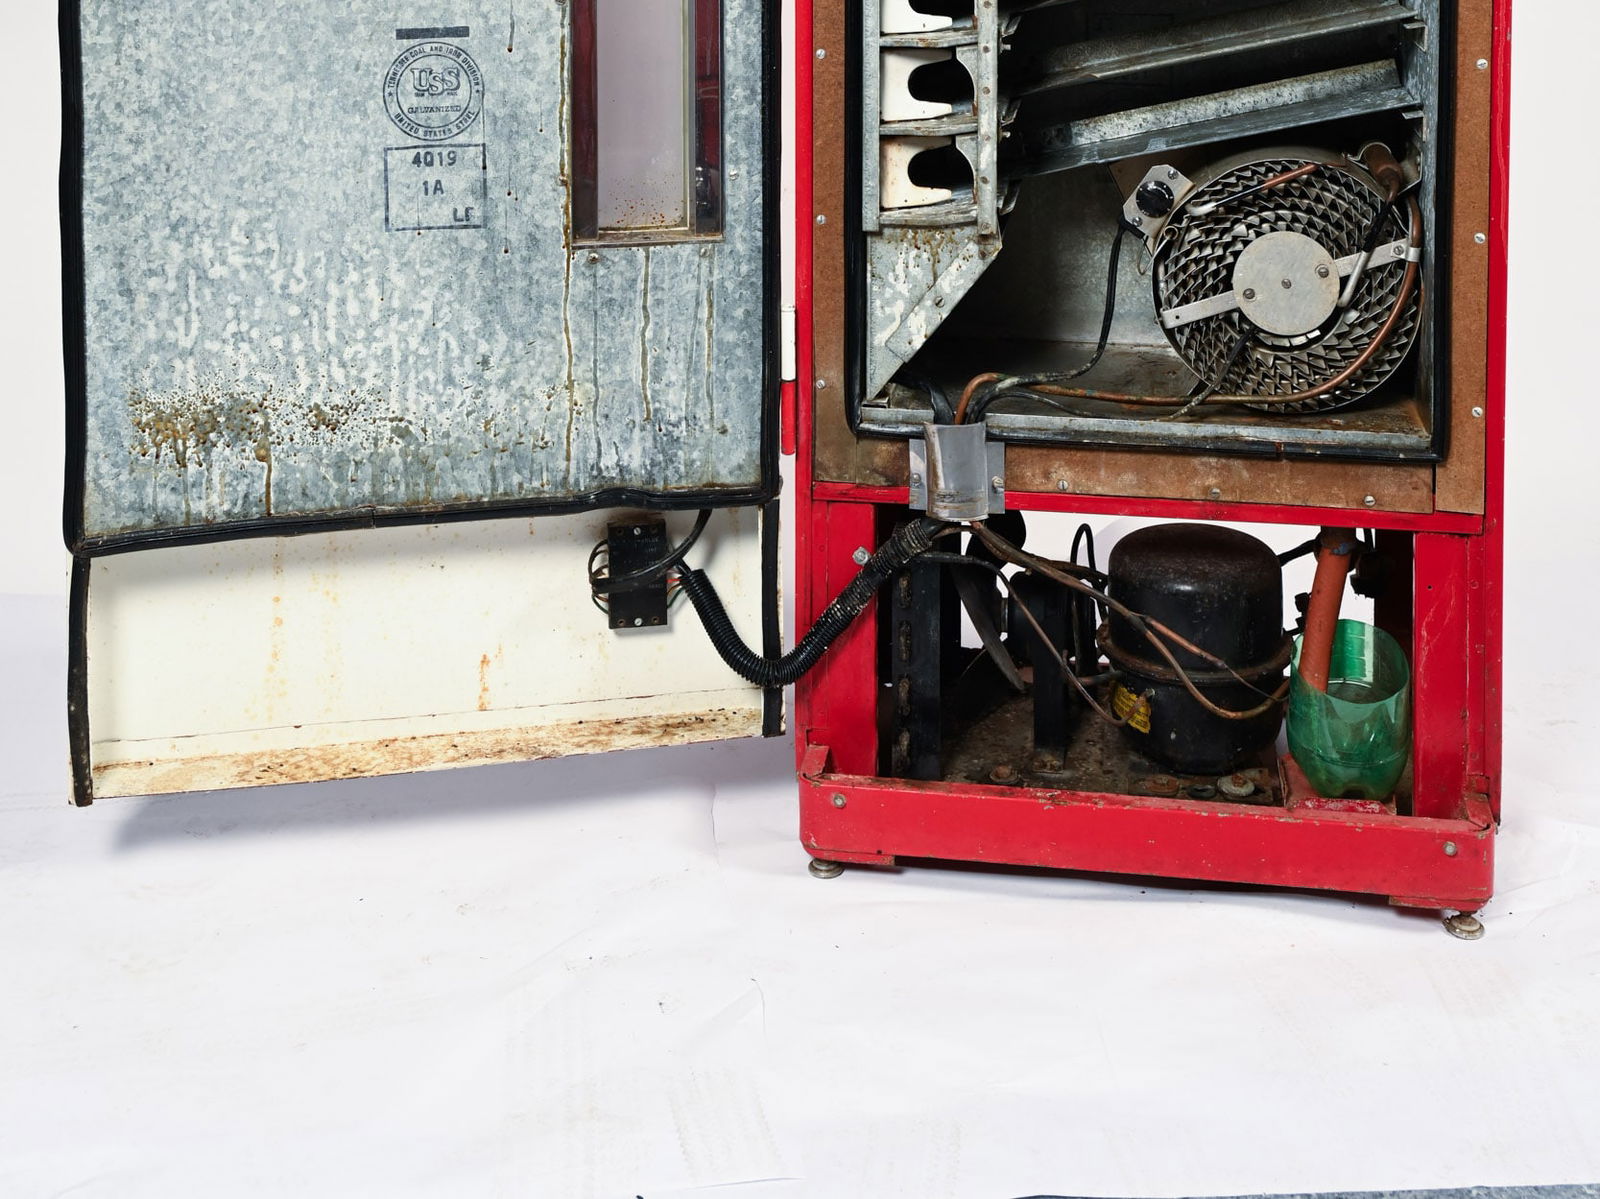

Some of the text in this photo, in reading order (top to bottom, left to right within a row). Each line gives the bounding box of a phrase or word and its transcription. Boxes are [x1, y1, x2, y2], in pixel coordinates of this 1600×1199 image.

[410, 47, 427, 58] COAL
[461, 57, 480, 87] DIVISION
[410, 66, 461, 96] USS
[394, 110, 476, 138] UNITED STATES STEEL
